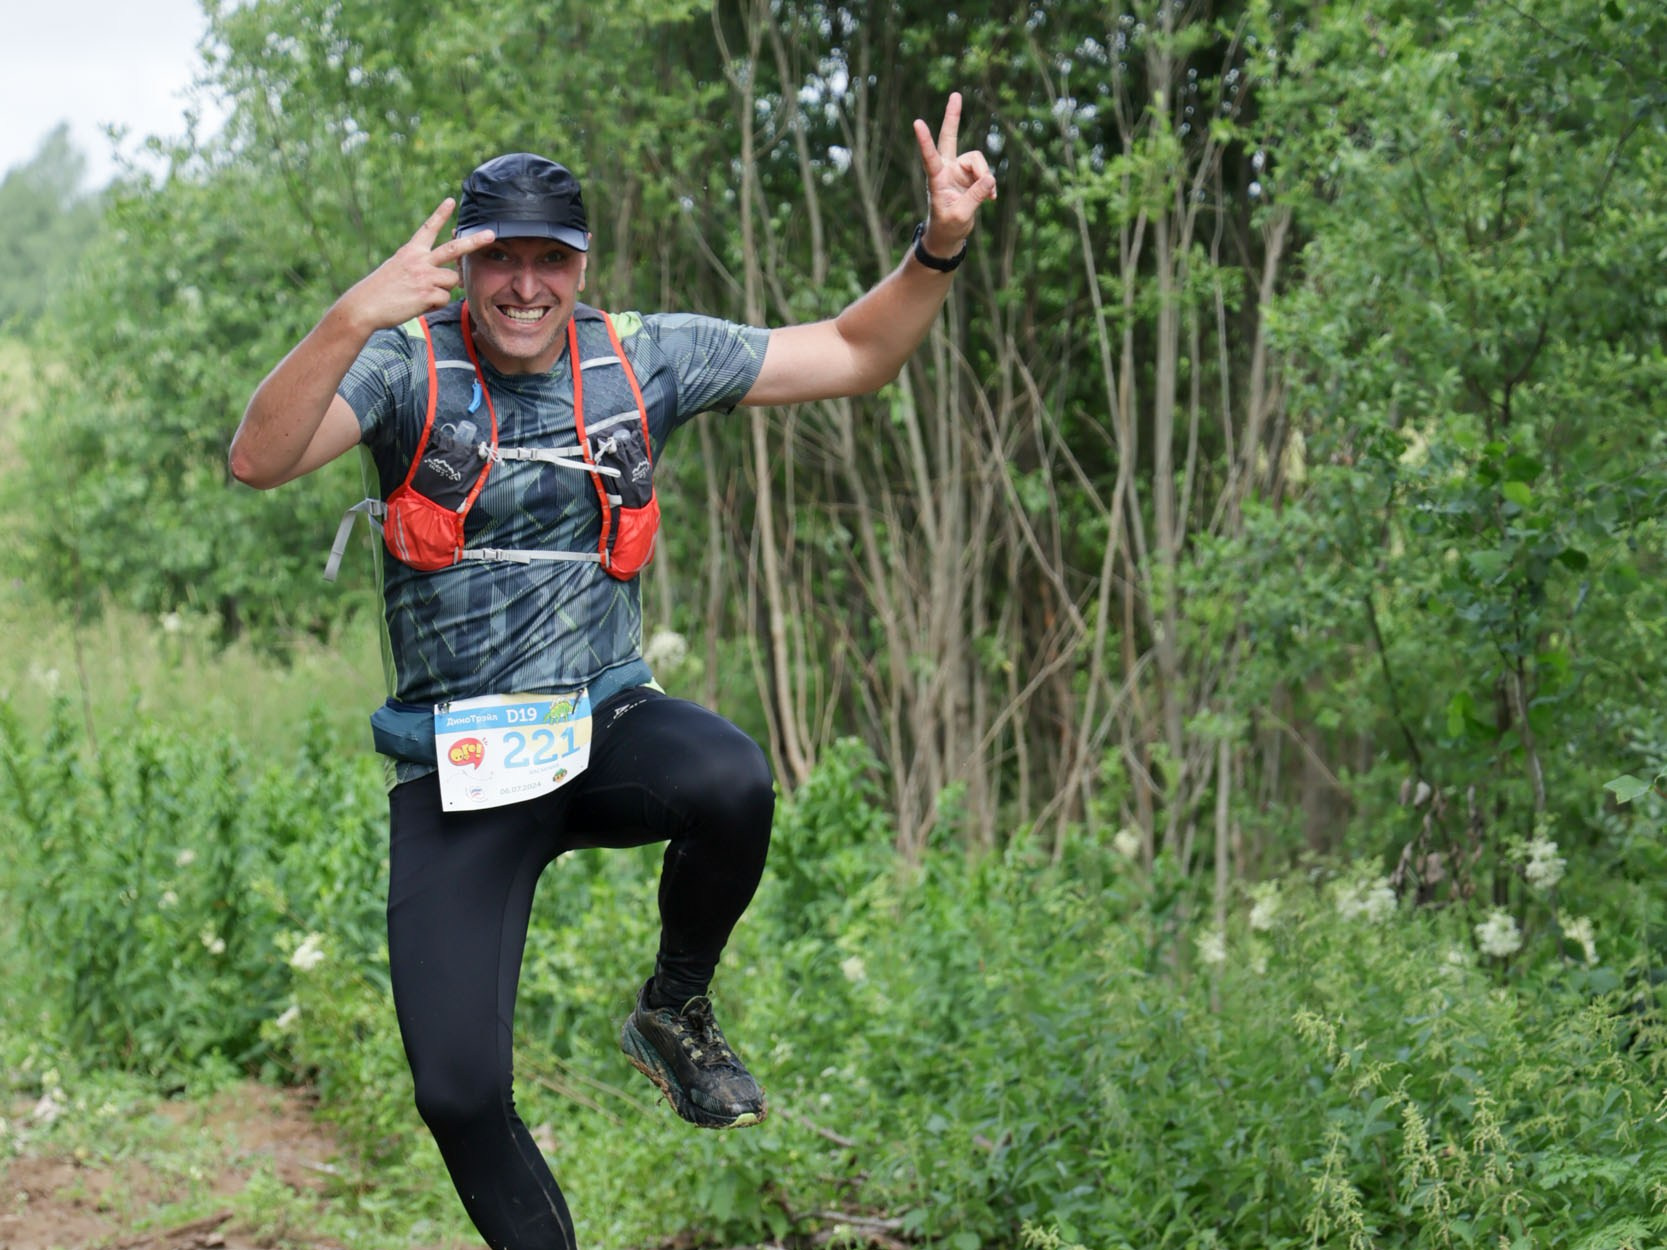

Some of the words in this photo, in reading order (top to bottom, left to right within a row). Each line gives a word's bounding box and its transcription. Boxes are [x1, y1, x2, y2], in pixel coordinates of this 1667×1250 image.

[446, 712, 498, 727] ДиноТрэйл
[506, 707, 538, 723] D19
[502, 726, 581, 769] 221
